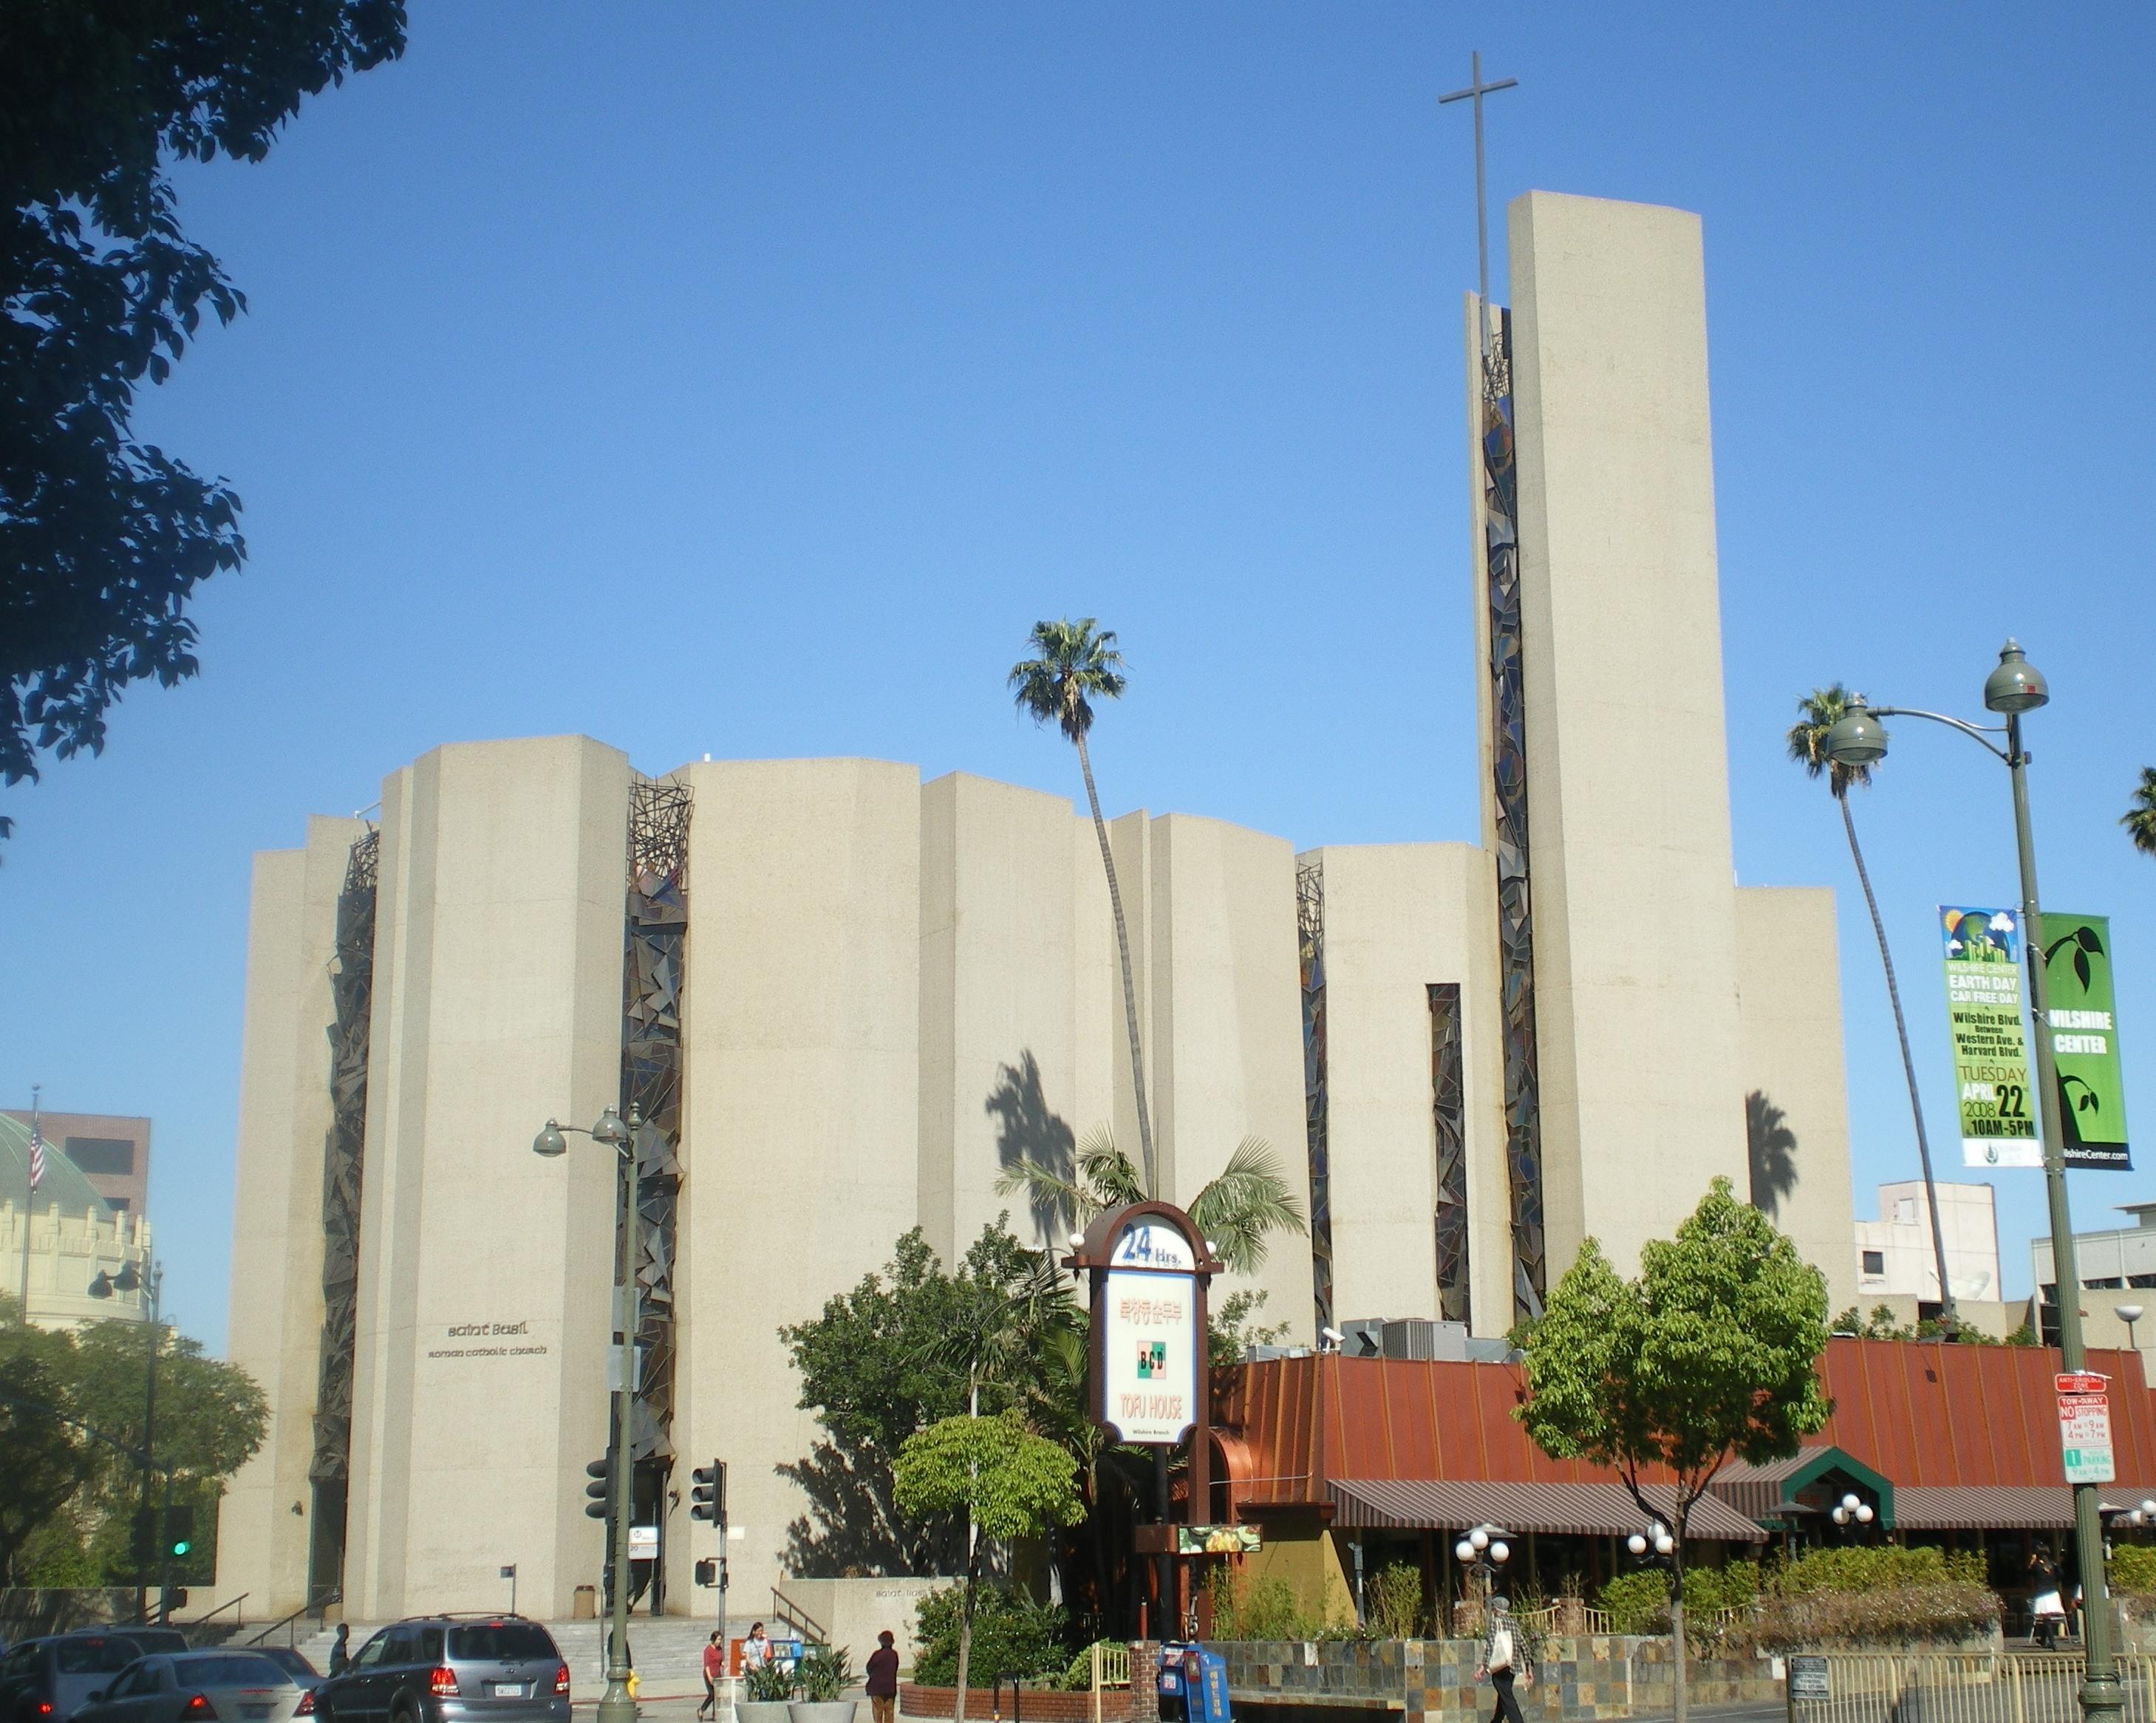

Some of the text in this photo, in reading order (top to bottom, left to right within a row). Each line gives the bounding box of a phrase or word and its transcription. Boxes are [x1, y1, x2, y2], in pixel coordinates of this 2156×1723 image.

[1948, 963, 2017, 975] WILSHIRE CENTER
[1949, 975, 2017, 991] EARTH DAY
[1951, 990, 2018, 1004] CAR FREE DAY
[1953, 1012, 2022, 1026] Wilshire Blvd.
[2049, 1009, 2112, 1030] WILSHIRE
[1975, 1025, 2003, 1034] Between
[1956, 1034, 2024, 1045] Western Ave. &
[2055, 1034, 2107, 1054] CENTER
[1962, 1045, 2022, 1057] Harvard Blvd.
[1959, 1065, 2027, 1082] TUESDAY
[1962, 1082, 1997, 1101] APRIL
[1964, 1101, 1996, 1117] 2008
[1971, 1119, 2035, 1136] 10AM-5PM
[2063, 1148, 2128, 1161] ilshireCenter.com
[1122, 1223, 1151, 1261] 24
[1140, 1351, 1163, 1370] BCD
[1120, 1394, 1182, 1419] TOFU HOUSE
[2061, 1397, 2104, 1405] TOW-AWAY
[2061, 1405, 2106, 1418] NO STOPPING
